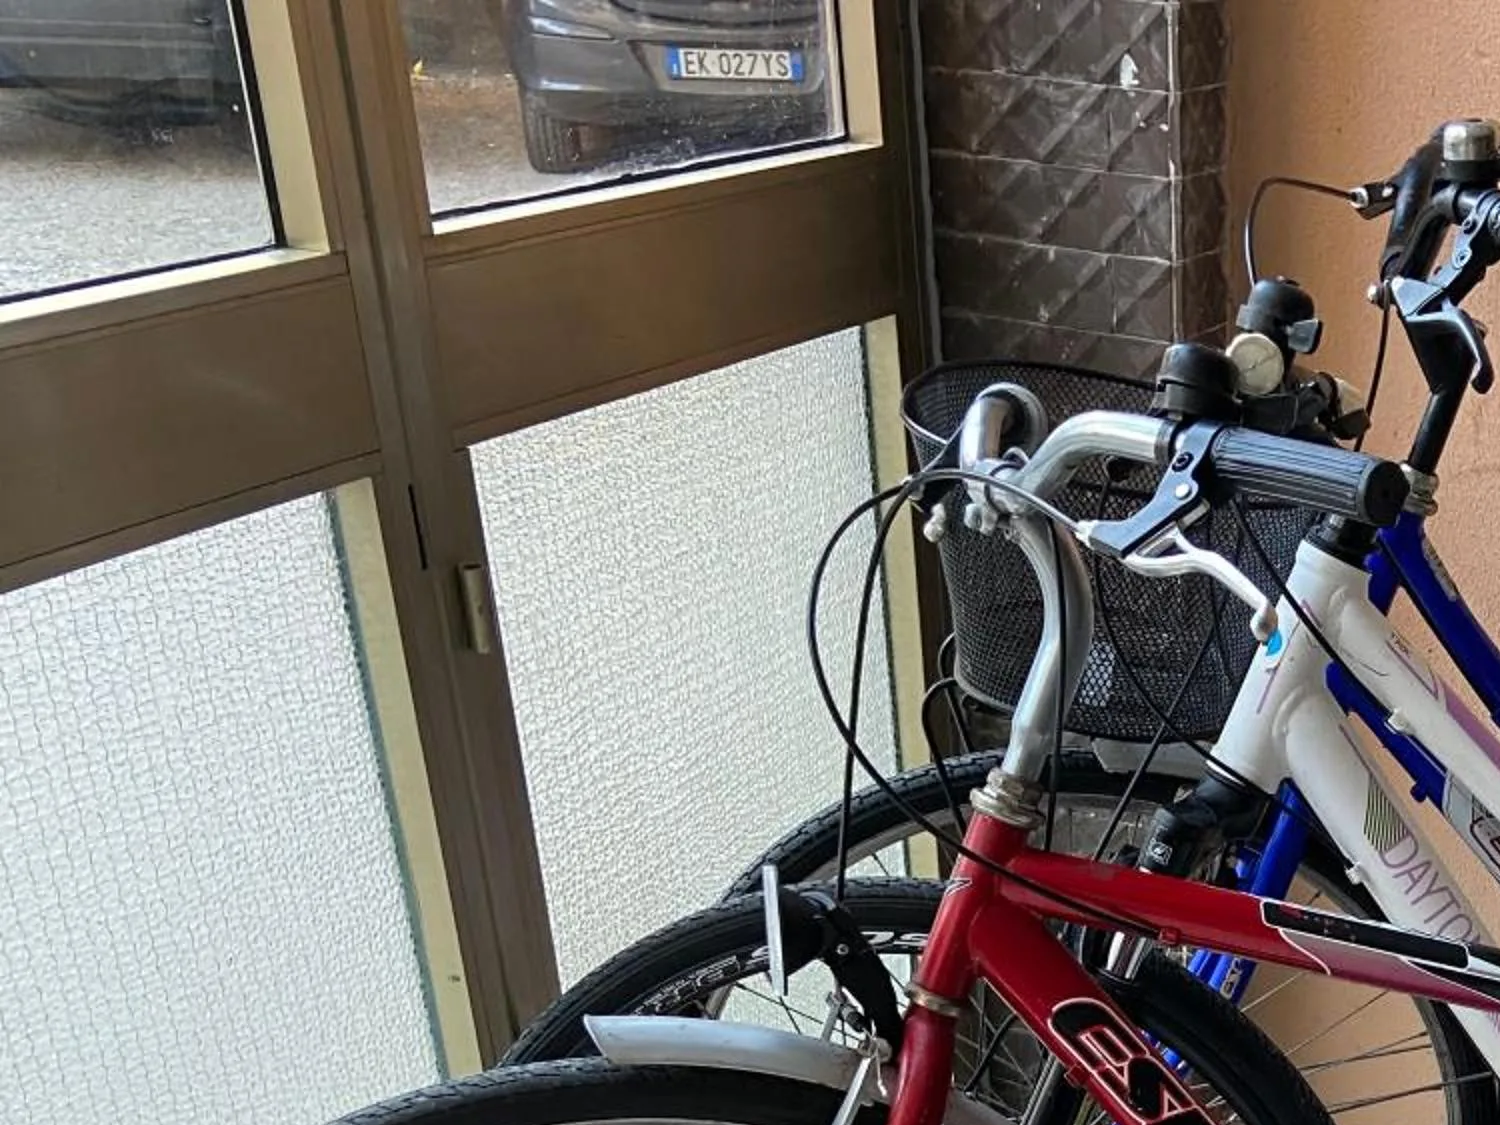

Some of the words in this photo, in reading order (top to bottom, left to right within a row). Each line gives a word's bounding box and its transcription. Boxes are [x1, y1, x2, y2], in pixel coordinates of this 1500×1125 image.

[683, 51, 711, 75] EK
[719, 52, 789, 77] 027YS
[1379, 828, 1481, 941] DAYTO
